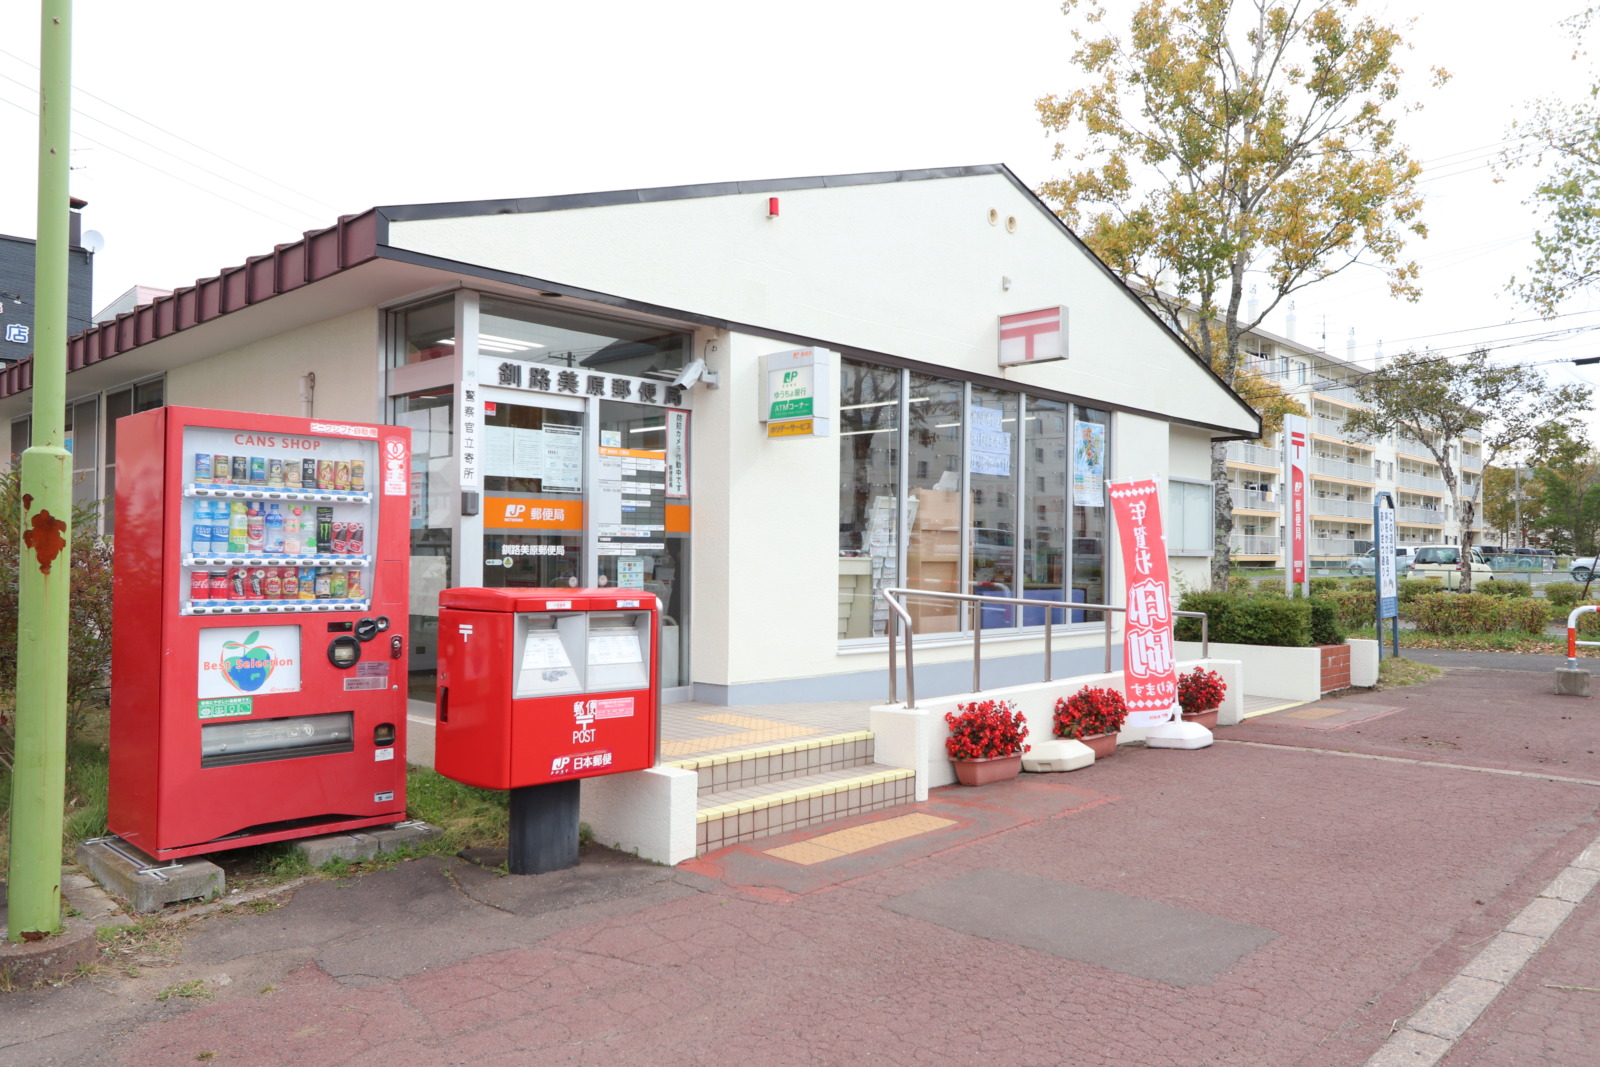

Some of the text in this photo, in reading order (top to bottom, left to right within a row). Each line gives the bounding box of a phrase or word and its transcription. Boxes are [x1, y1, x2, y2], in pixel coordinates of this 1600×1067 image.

[6, 324, 29, 343] 店
[498, 362, 683, 407] 釧路美原郵便局
[774, 387, 807, 399] ゆうちょ銀行
[234, 434, 321, 451] CANS SHOP
[464, 390, 476, 480] 警察官立寄所
[530, 507, 565, 521] 郵便局
[502, 544, 565, 556] 釧路美原郵便局
[203, 658, 293, 671] Best Selection
[573, 699, 597, 717] 郵便
[572, 729, 596, 744] POST
[574, 753, 612, 770] 日本郵便
